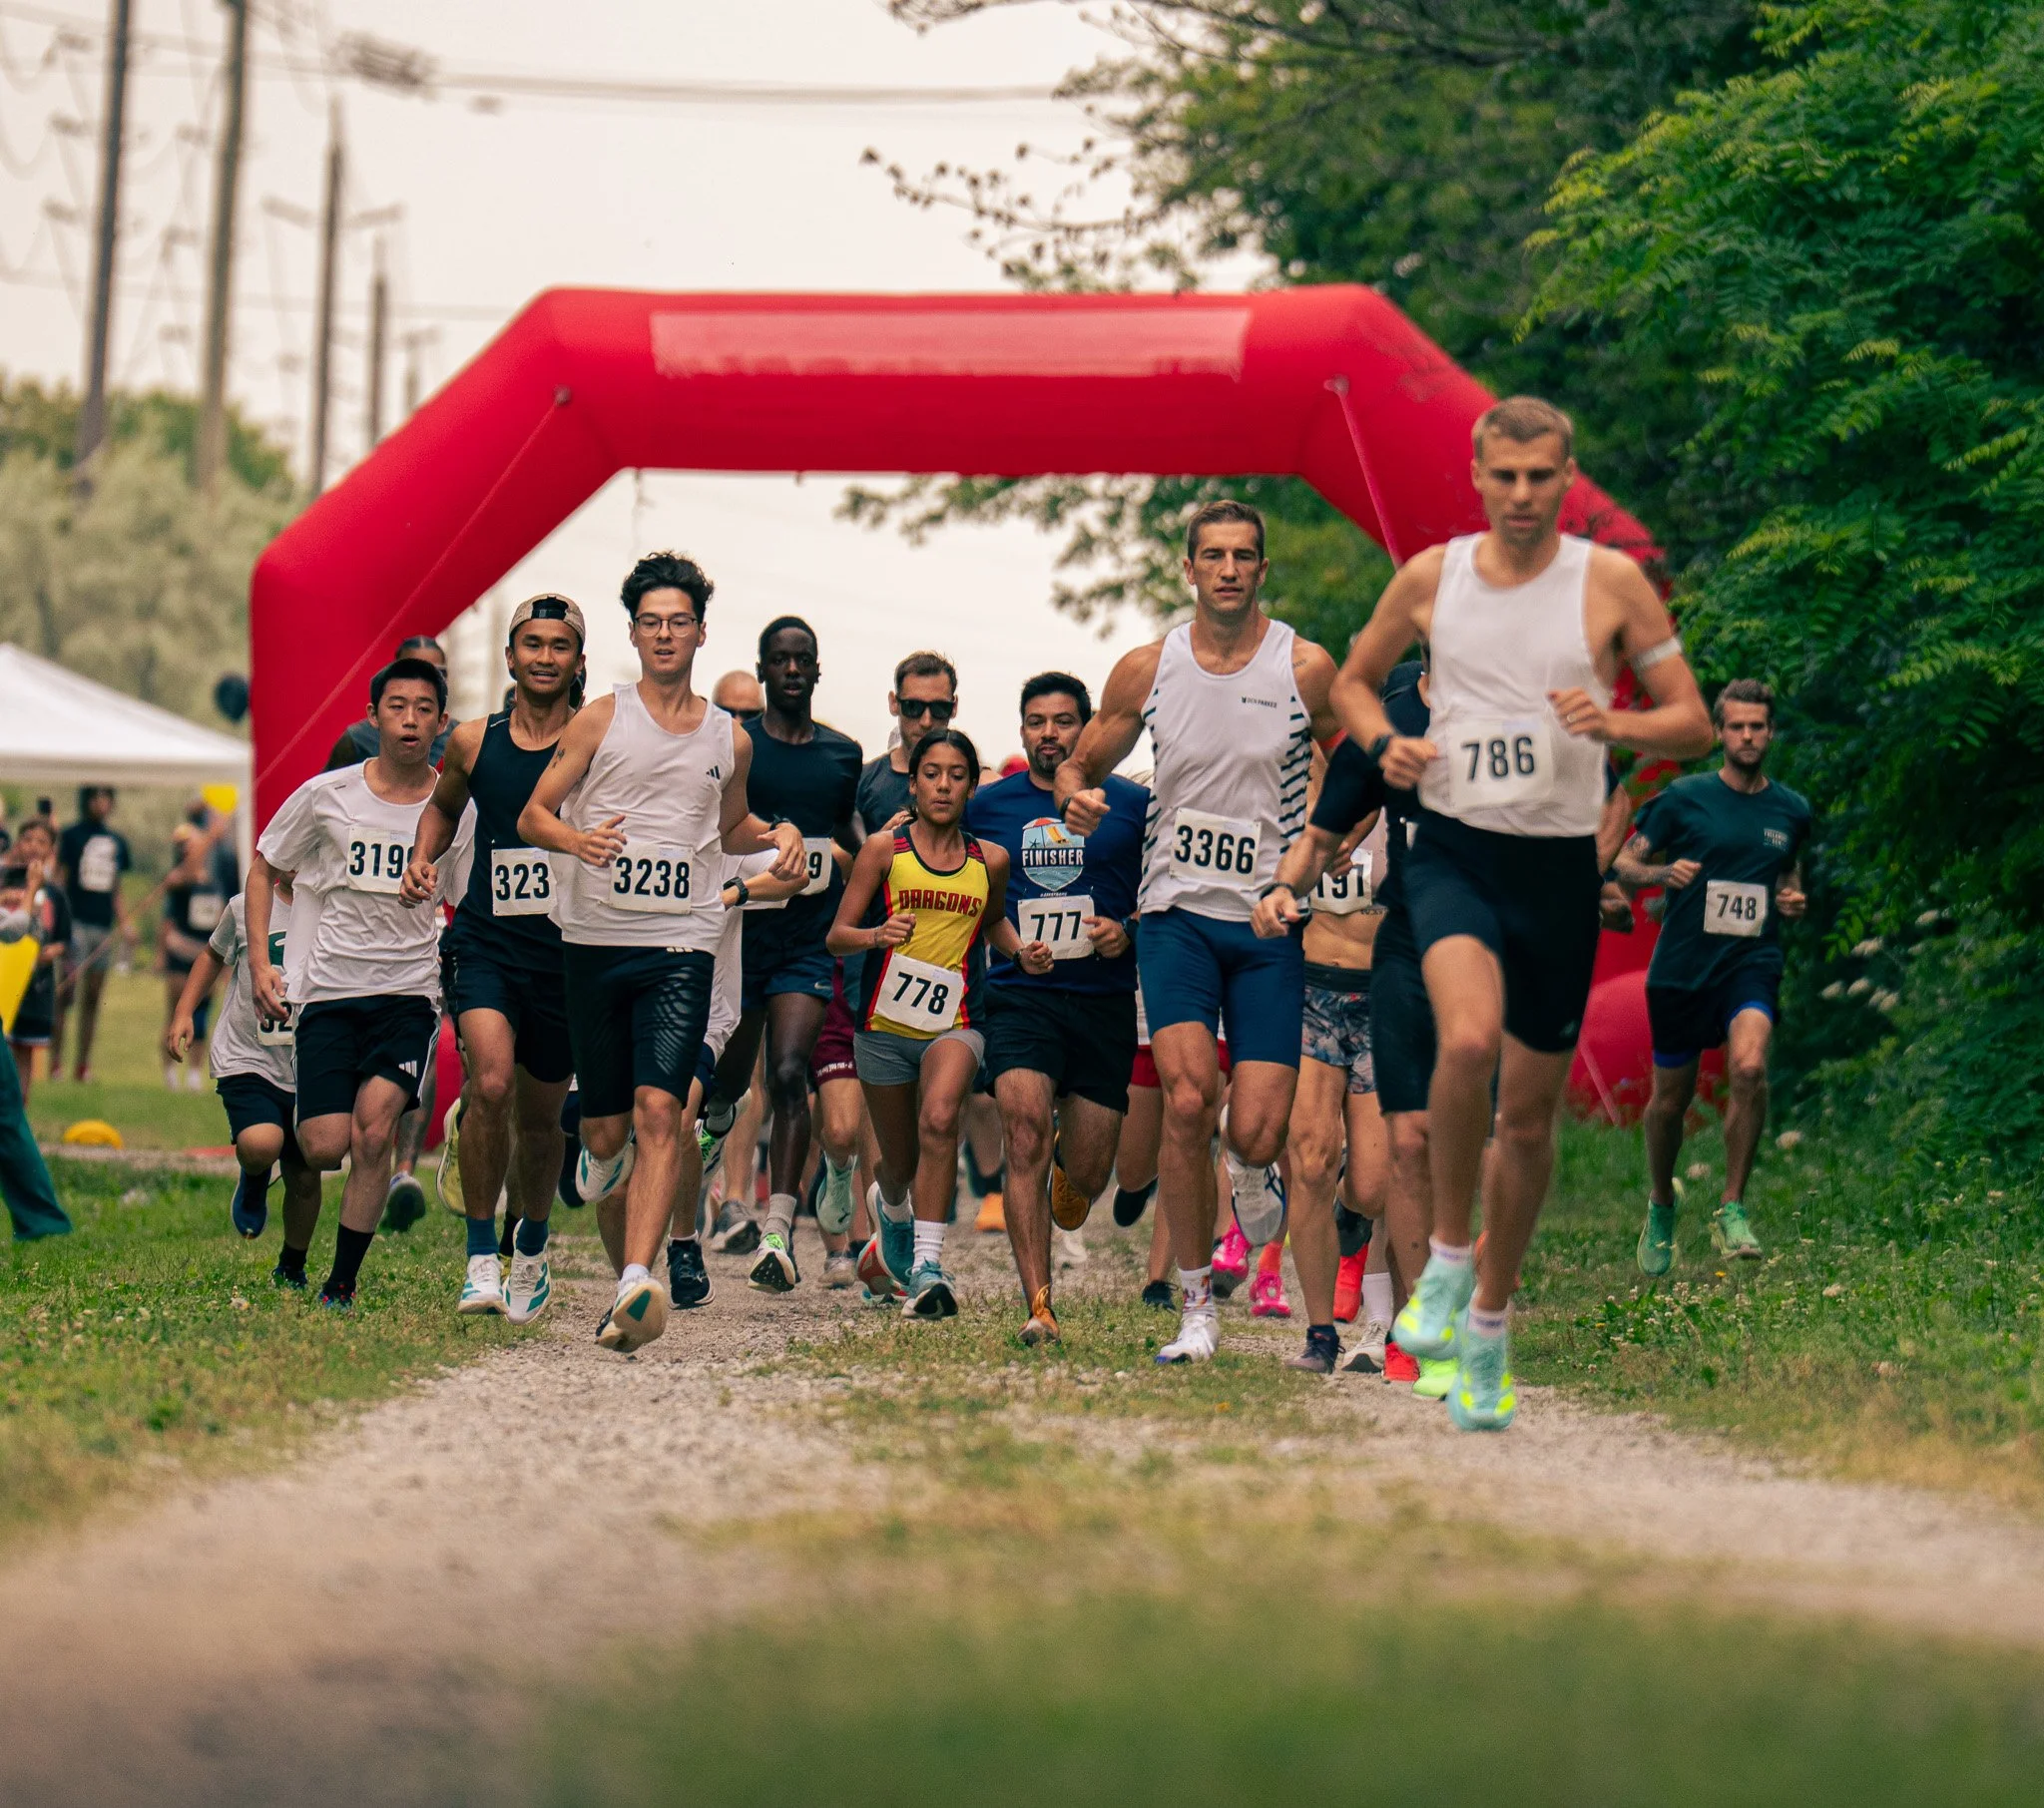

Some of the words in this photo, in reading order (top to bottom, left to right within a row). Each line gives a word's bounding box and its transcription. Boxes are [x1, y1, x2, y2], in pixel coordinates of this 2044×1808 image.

[1461, 734, 1536, 783] 786
[1021, 848, 1084, 867] FINISHER
[1174, 824, 1256, 875] 3366
[613, 856, 691, 899] 3238
[898, 889, 983, 918] DRAGONS
[1717, 893, 1757, 921] 748
[1029, 910, 1082, 942] 777
[892, 971, 949, 1016] 778
